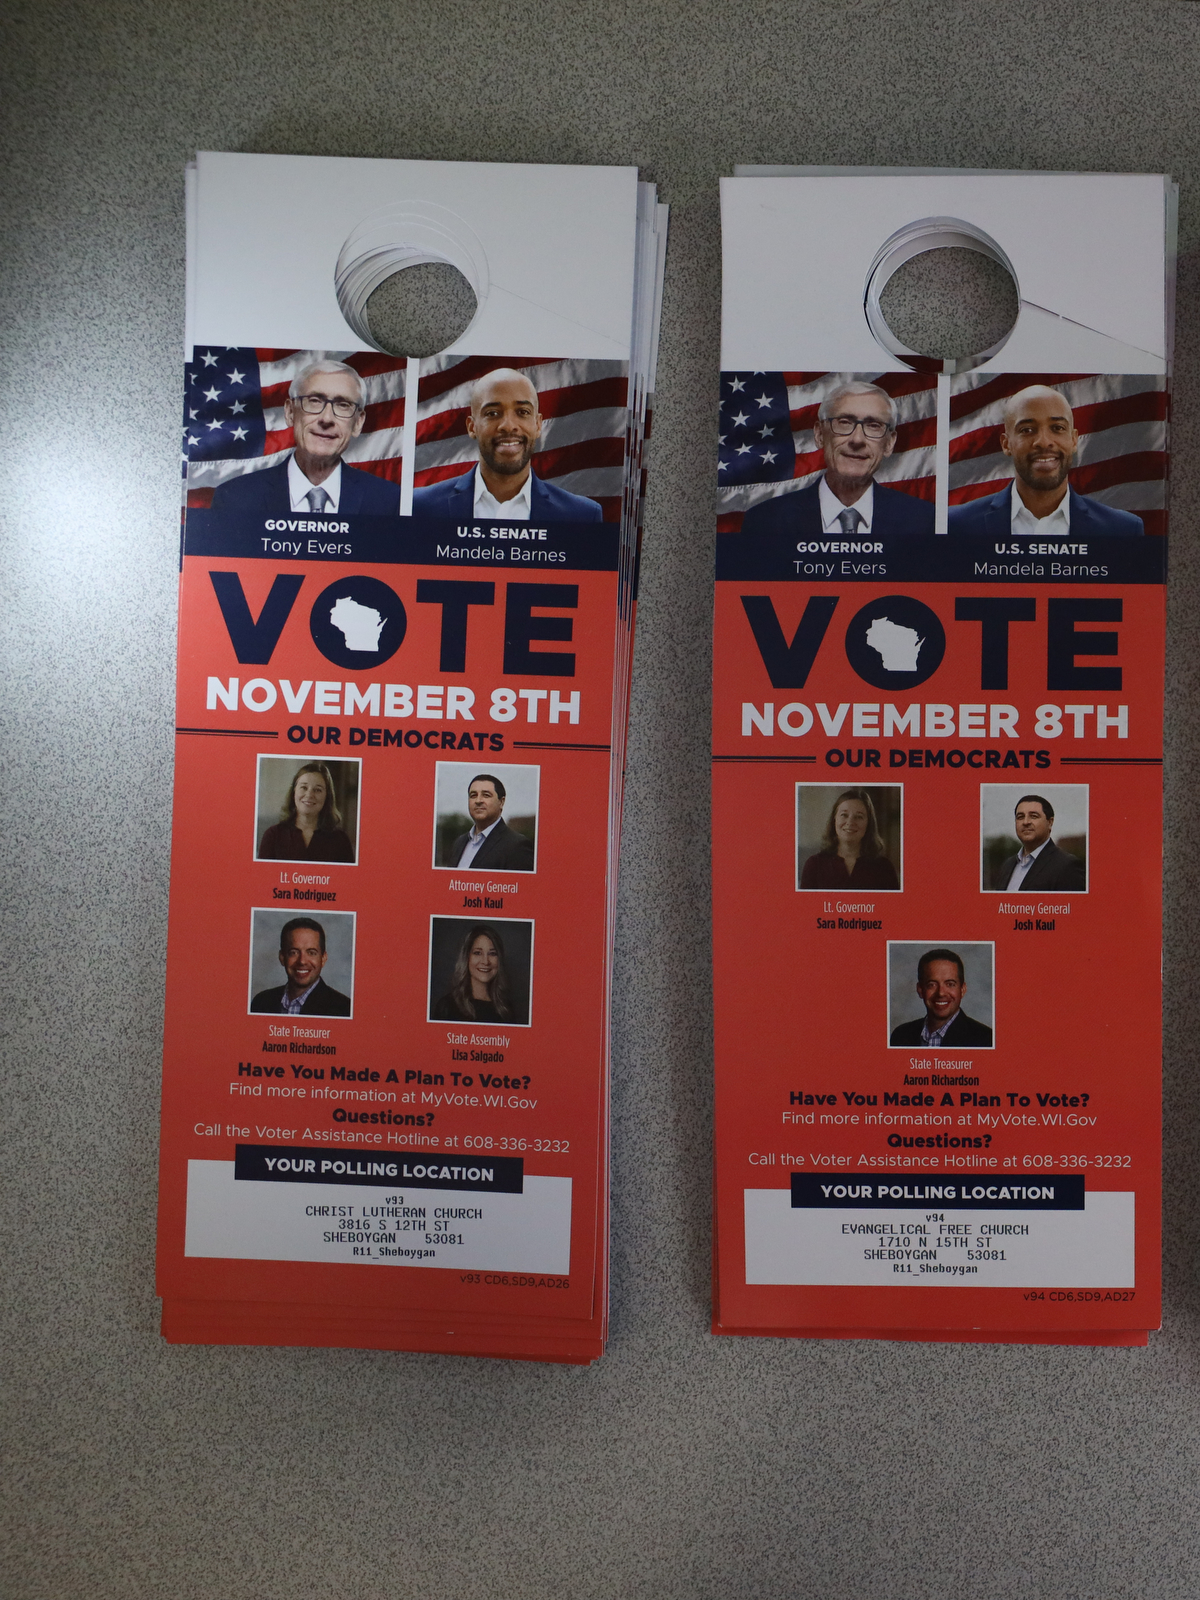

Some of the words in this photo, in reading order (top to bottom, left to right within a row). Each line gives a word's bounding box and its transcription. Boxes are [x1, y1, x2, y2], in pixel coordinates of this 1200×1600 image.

[265, 519, 349, 533] GOVERNOR
[457, 526, 485, 539] U.S.
[490, 527, 547, 540] SENATE
[261, 538, 302, 555] Tony
[308, 540, 352, 555] Evers
[436, 544, 505, 560] Mandela
[510, 547, 566, 562] Barnes
[797, 542, 883, 554] GOVERNOR
[995, 543, 1024, 555] U.S.
[1029, 543, 1088, 556] SENATE
[793, 560, 835, 577] Tony
[841, 561, 887, 575] Evers
[974, 562, 1044, 576] Mandela
[1050, 562, 1108, 577] Barnes
[208, 570, 579, 677] VOTE
[739, 594, 1124, 692] VOTE
[206, 676, 476, 720] NOVEMBER
[489, 688, 580, 724] 8TH
[742, 702, 1020, 738] NOVEMBER
[1034, 704, 1128, 739] 8TH
[287, 725, 341, 745] OUR
[349, 727, 504, 752] DEMOCRATS
[825, 748, 881, 768] OUR
[889, 749, 1051, 769] DEMOCRATS
[824, 901, 834, 913] Lt.
[836, 901, 875, 913] Governor
[817, 917, 836, 929] Sara
[838, 917, 882, 931] Rodriguez
[269, 1025, 291, 1037] State
[293, 1026, 331, 1039] Treasurer
[447, 1032, 468, 1045] State
[470, 1033, 510, 1048] Assembly
[262, 1041, 287, 1054] Aaron
[289, 1042, 336, 1056] Richardson
[452, 1049, 468, 1061] Lisa
[470, 1050, 504, 1064] Salgado
[790, 1091, 837, 1106] Have
[842, 1092, 877, 1107] You
[884, 1092, 935, 1107] Made
[940, 1092, 955, 1106] A
[960, 1092, 1001, 1107] Plan
[1006, 1093, 1031, 1107] To
[1036, 1093, 1090, 1108] Vote?
[332, 1108, 435, 1127] Questions?
[887, 1132, 992, 1151] Questions?
[264, 1158, 316, 1173] YOUR
[321, 1160, 398, 1177] POLLING
[403, 1164, 494, 1181] LOCATION
[821, 1185, 873, 1198] YOUR
[878, 1185, 956, 1199] POLLING
[962, 1186, 1055, 1200] LOCATION
[385, 1196, 404, 1205] v93
[305, 1205, 354, 1217] CHRIST
[363, 1206, 426, 1218] LUTHERAN
[434, 1208, 482, 1219] CHURCH
[926, 1213, 945, 1222] v94
[338, 1219, 370, 1230] 3816
[379, 1219, 387, 1230] S
[395, 1220, 426, 1231] 12TH
[434, 1220, 450, 1231] ST
[842, 1224, 931, 1235] EVANGELICAL
[939, 1224, 972, 1235] FREE
[980, 1224, 1029, 1235] CHURCH
[323, 1231, 396, 1244] SHEBOYGAN
[425, 1233, 464, 1245] 53081
[879, 1236, 910, 1247] 1710
[919, 1237, 927, 1247] N
[936, 1237, 968, 1248] 15TH
[976, 1237, 992, 1248] ST
[353, 1246, 435, 1259] R11_Sheboygan
[864, 1249, 937, 1260] SHEBOYGAN
[967, 1250, 1007, 1261] 53081
[893, 1263, 978, 1276] R11_Sheboygan
[460, 1274, 480, 1284] v93
[1023, 1291, 1045, 1301] v94
